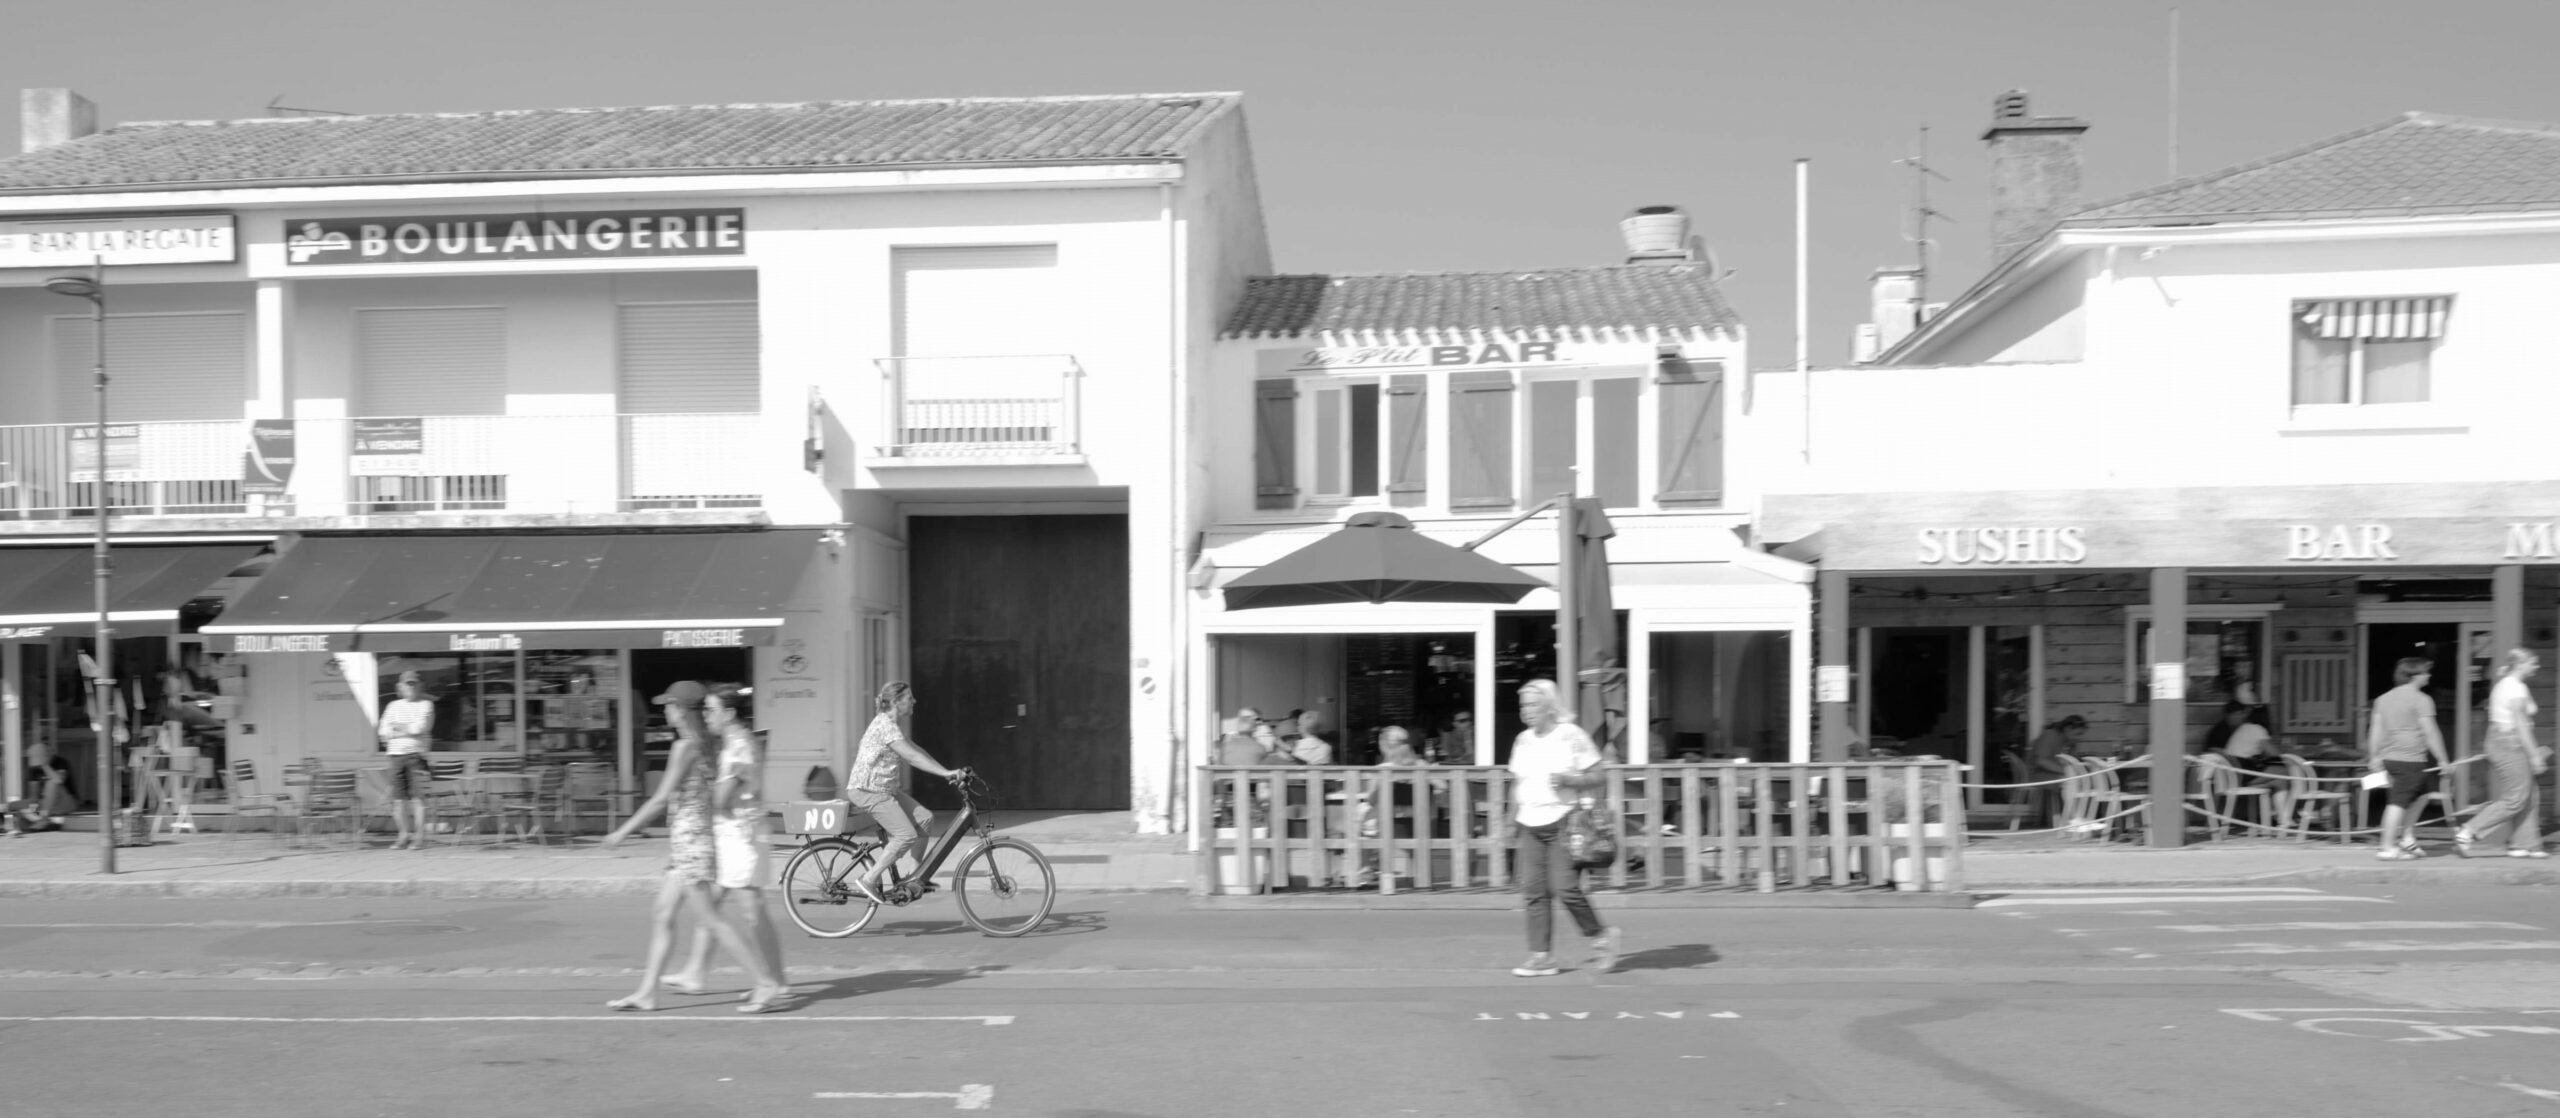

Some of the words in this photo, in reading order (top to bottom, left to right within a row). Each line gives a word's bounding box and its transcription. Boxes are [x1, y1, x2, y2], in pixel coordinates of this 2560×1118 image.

[29, 232, 78, 252] BAR
[88, 231, 117, 251] LA
[360, 215, 740, 256] BOULANGERIE
[1432, 342, 1556, 366] BAR
[83, 426, 139, 438] VNDRE
[1917, 527, 2086, 565] SUSHIS
[2286, 523, 2398, 561] BAR
[2503, 522, 2560, 560] M
[234, 635, 328, 652] BOULANGERIE
[804, 808, 835, 831] NO
